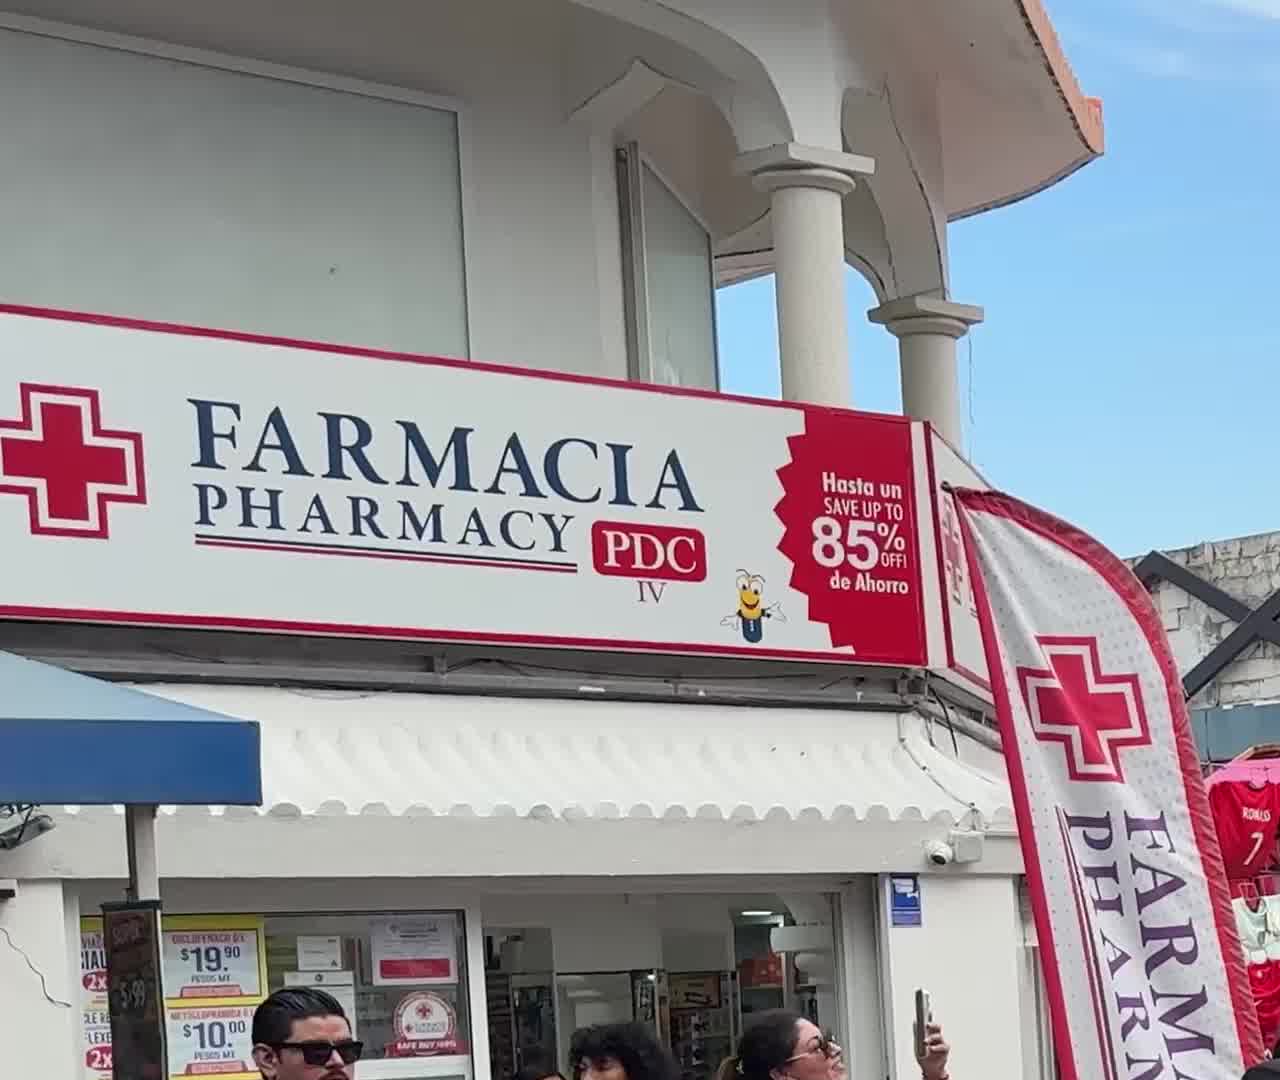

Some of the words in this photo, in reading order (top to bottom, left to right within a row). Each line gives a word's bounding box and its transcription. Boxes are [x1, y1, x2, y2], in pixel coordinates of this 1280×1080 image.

[187, 398, 705, 513] FARMACIA
[822, 472, 875, 497] Hasta
[881, 482, 902, 500] un
[193, 483, 576, 553] PHARMACY
[825, 497, 859, 518] SAVE
[863, 501, 881, 519] UP
[885, 503, 904, 521] TO
[601, 530, 697, 573] PDC
[637, 580, 667, 603] IV
[830, 571, 851, 591] de
[855, 573, 909, 595] Ahorro
[1243, 832, 1264, 865] 7
